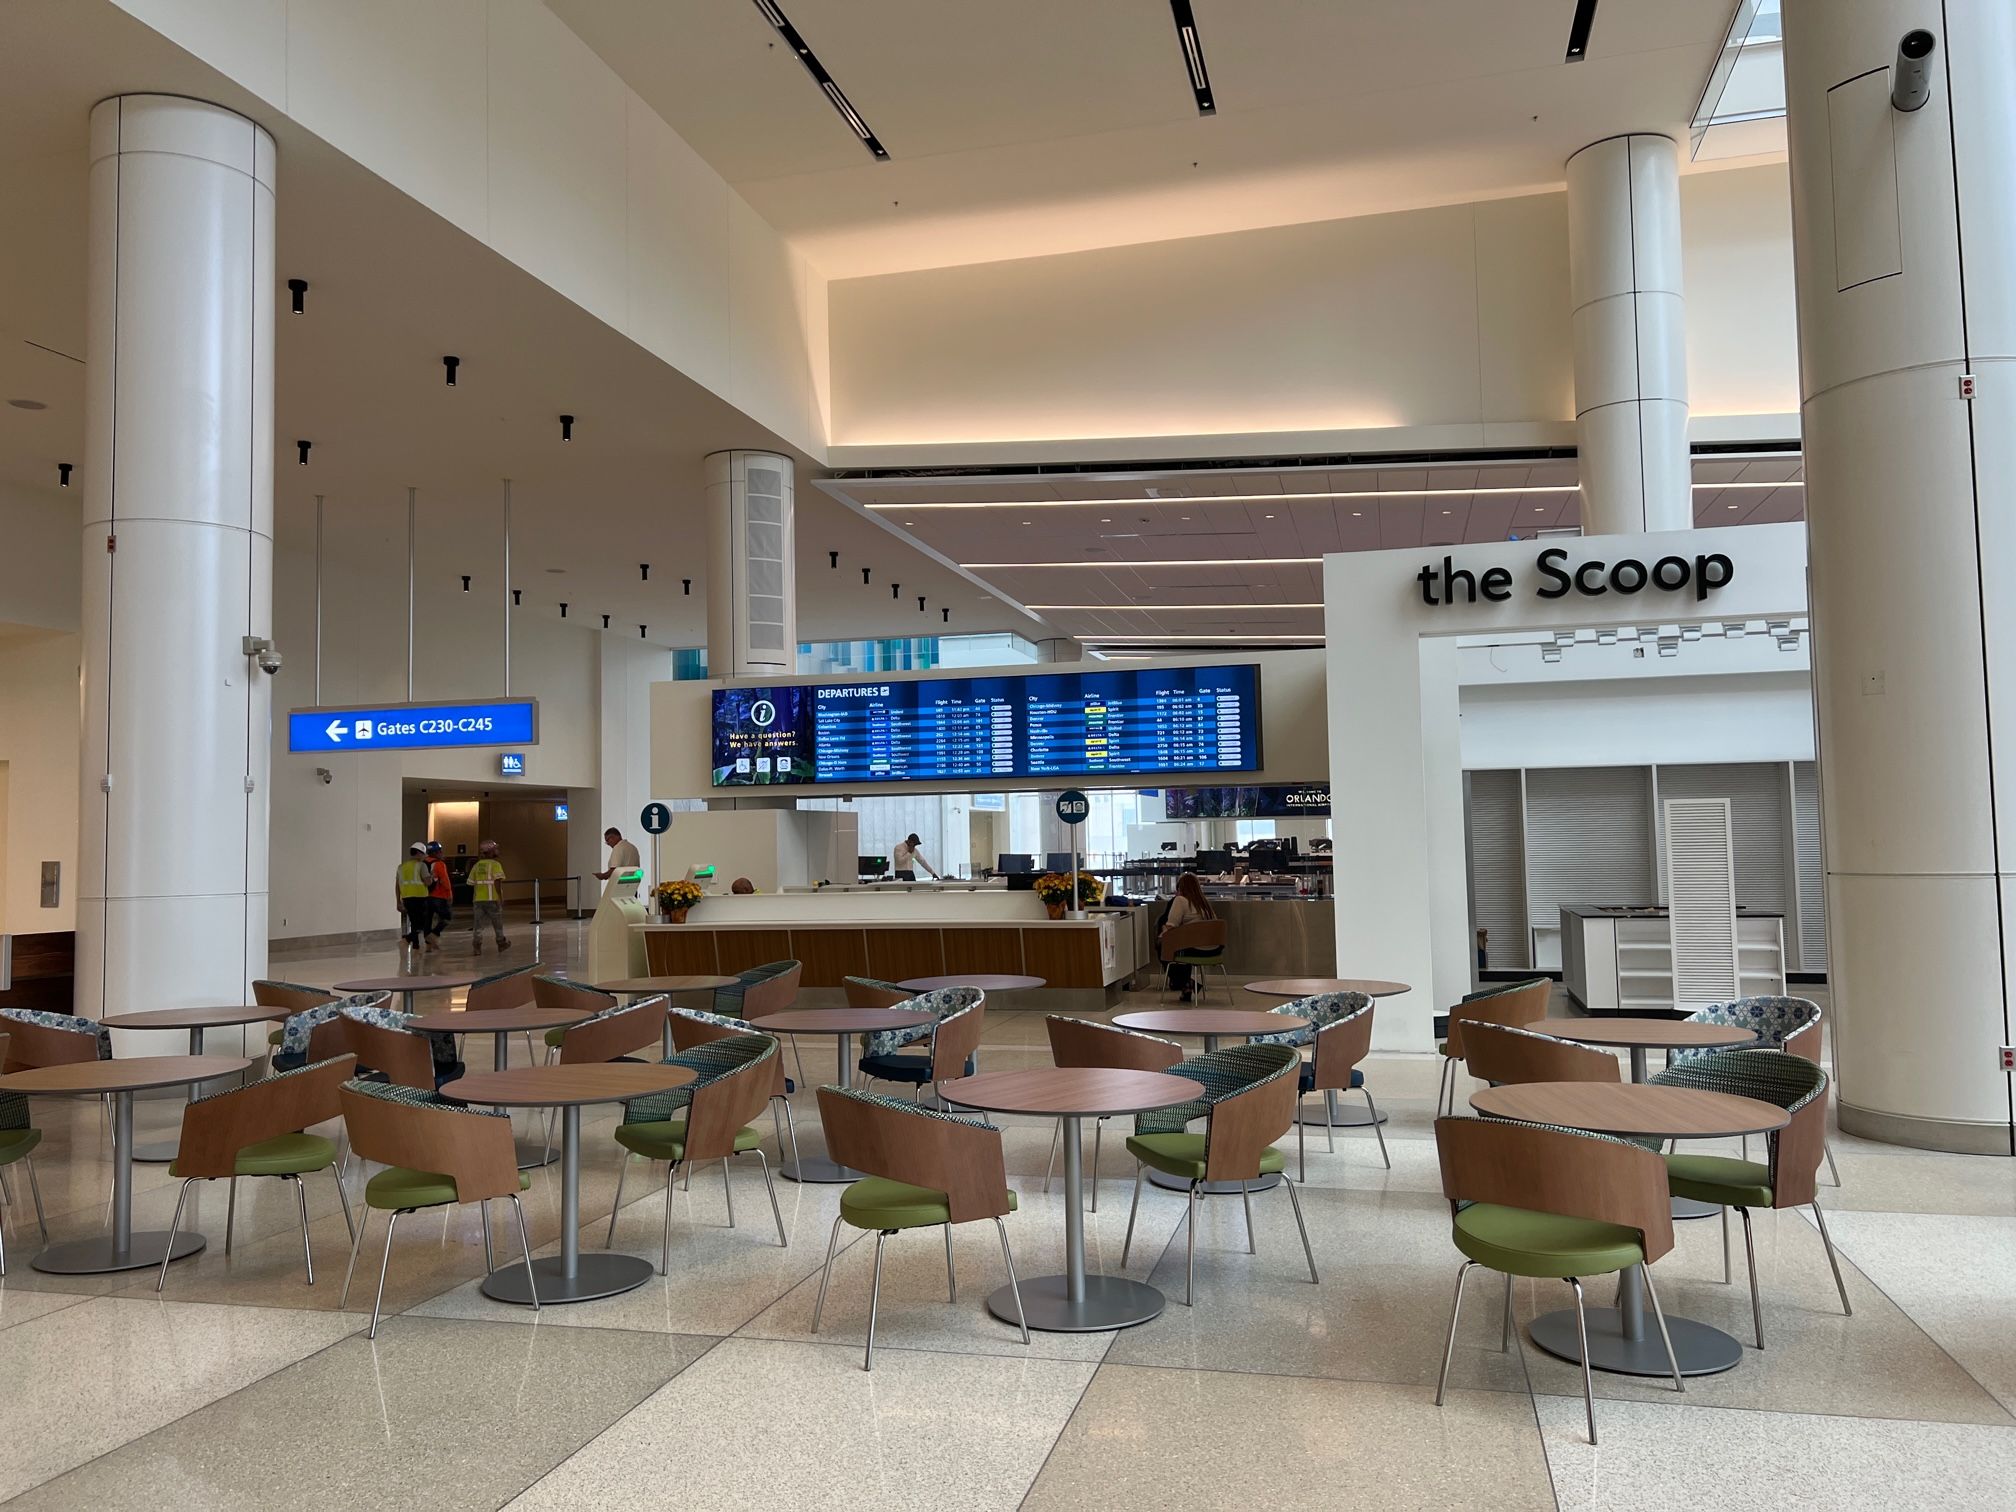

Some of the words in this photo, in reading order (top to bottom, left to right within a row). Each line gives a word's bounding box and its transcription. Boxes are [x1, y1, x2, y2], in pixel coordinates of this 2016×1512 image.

[1417, 556, 1513, 606] the
[1536, 548, 1734, 602] Scoop
[818, 687, 878, 698] DEPARTURES
[378, 722, 416, 736] Gates
[419, 718, 492, 733] C230-C245
[758, 731, 795, 739] question?
